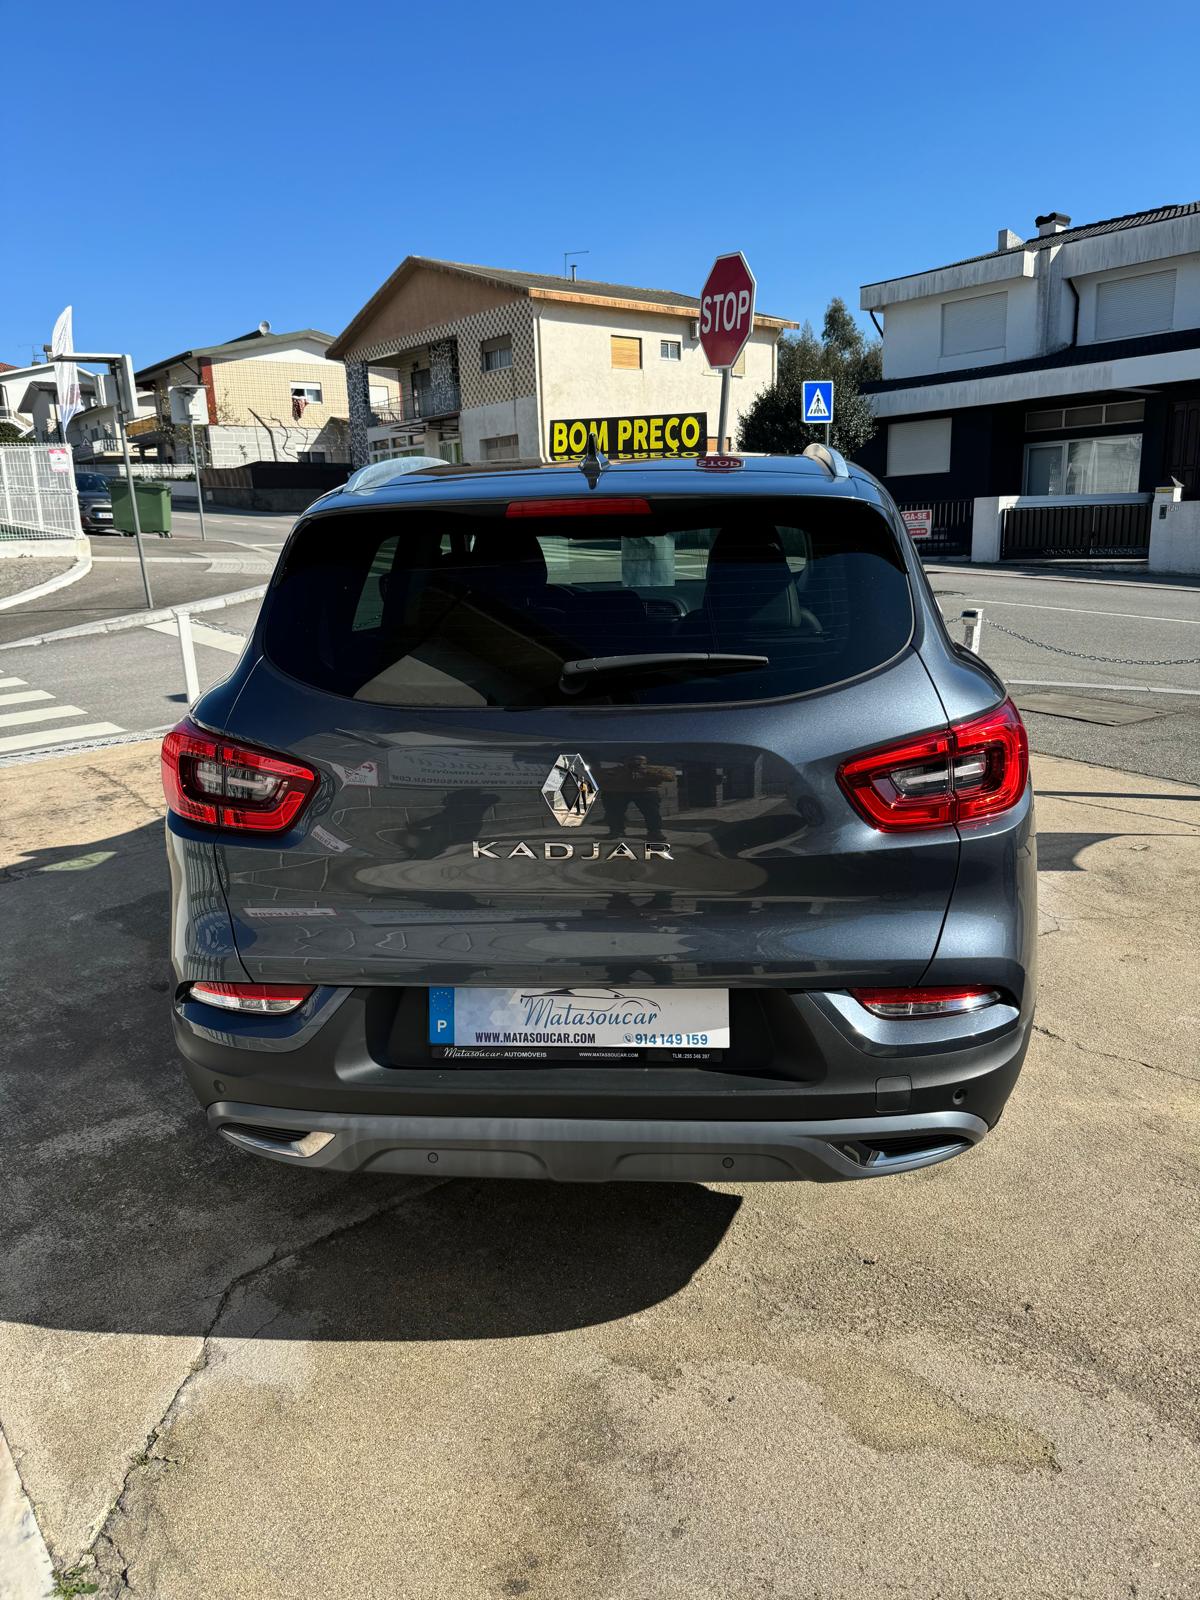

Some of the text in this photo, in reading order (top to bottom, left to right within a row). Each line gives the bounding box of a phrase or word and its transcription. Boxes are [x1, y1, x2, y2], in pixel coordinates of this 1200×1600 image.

[701, 290, 750, 334] STOP
[553, 416, 700, 453] BOM PREÇO
[471, 840, 675, 861] KADJAR
[524, 997, 658, 1029] Matasoucar
[437, 1020, 448, 1033] P
[475, 1032, 708, 1045] WWW.MATASOUCAR.COM 914 149 159
